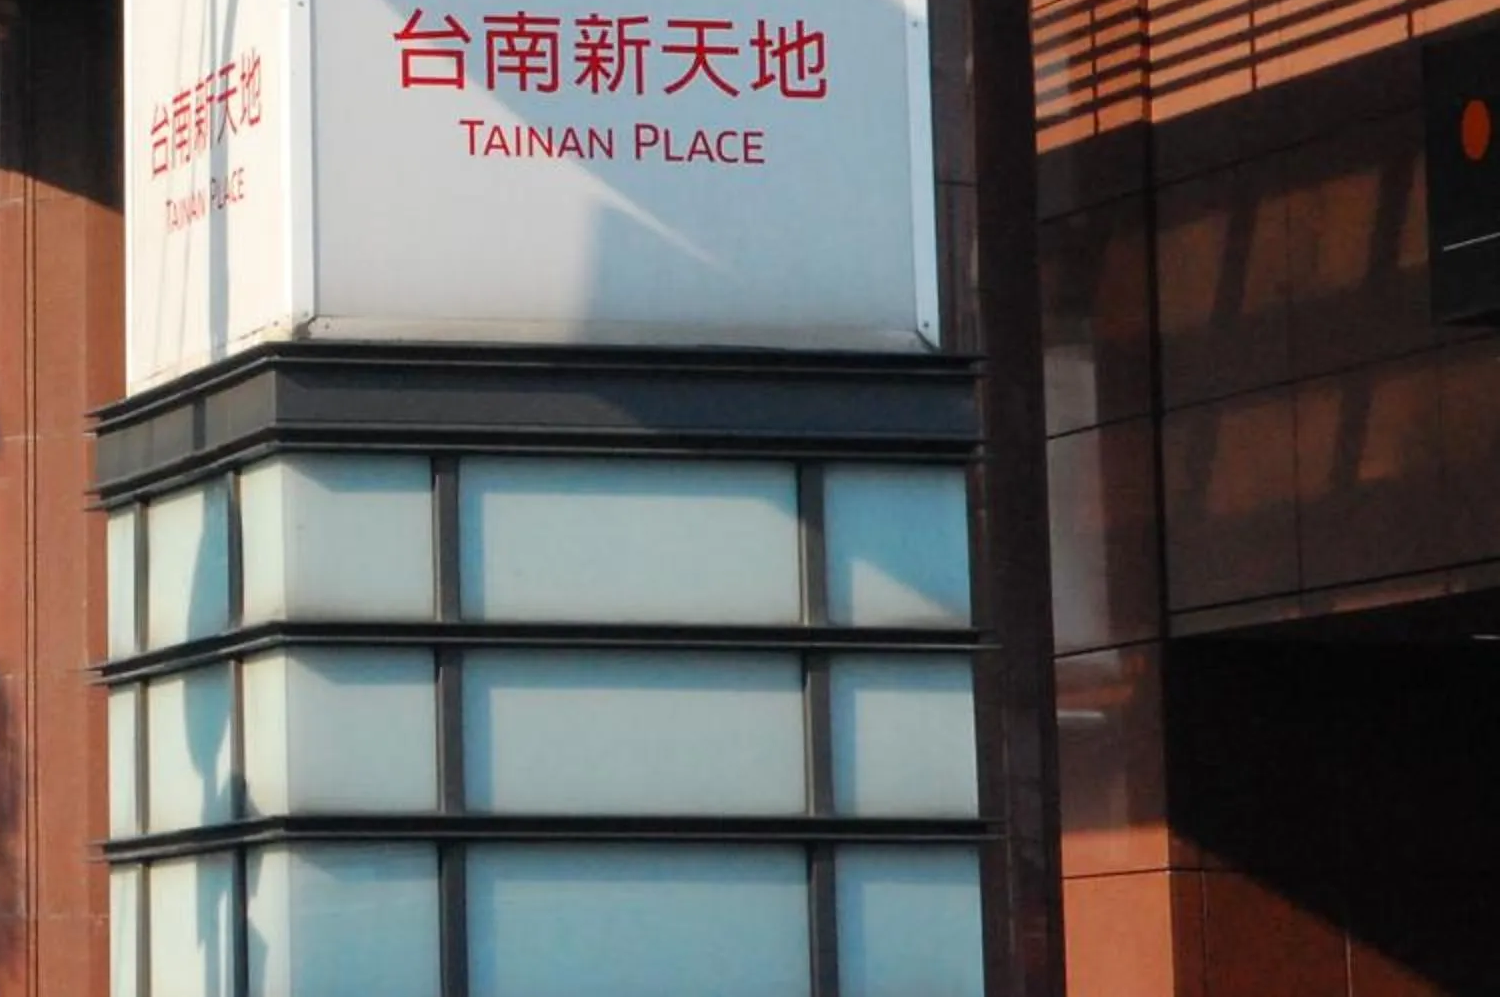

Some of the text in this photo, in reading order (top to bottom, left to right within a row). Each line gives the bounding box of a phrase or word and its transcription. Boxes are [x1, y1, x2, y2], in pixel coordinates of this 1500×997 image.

[394, 8, 828, 99] 台南新天地
[151, 48, 261, 178] 台南新天地
[459, 120, 765, 164] TAINAN PLACE
